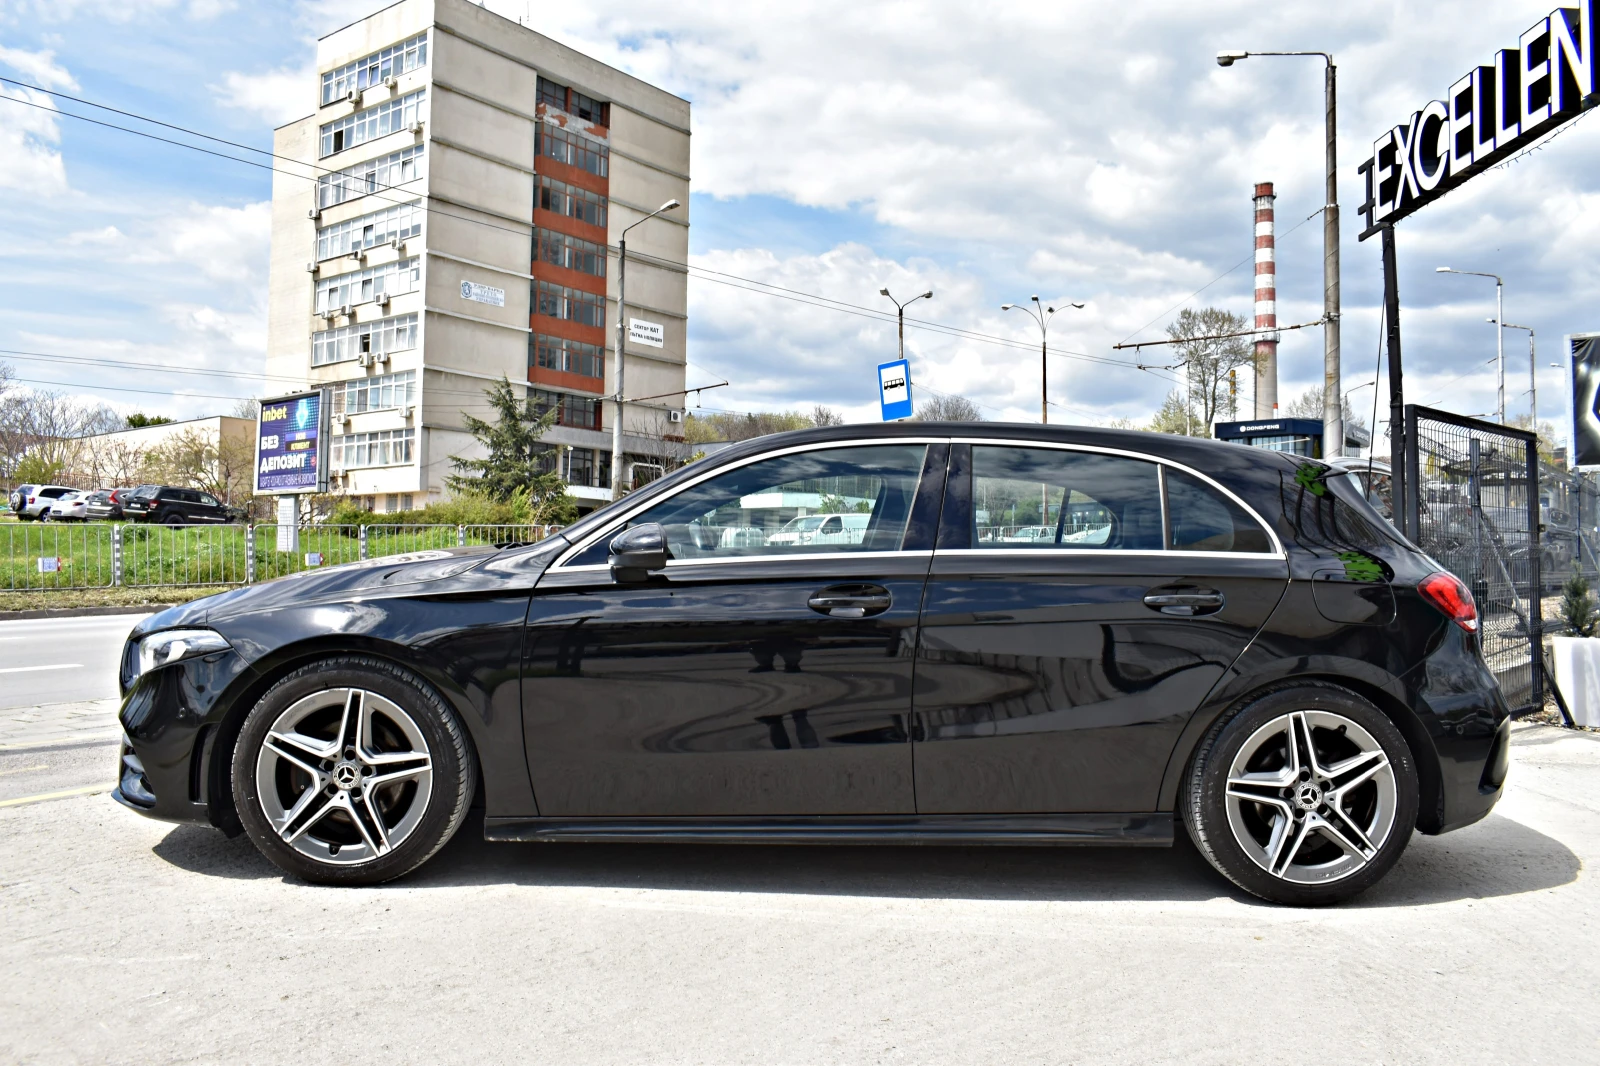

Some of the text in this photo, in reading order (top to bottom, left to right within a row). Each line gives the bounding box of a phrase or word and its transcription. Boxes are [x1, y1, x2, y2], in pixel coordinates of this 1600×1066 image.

[262, 405, 287, 422] inbet
[260, 435, 279, 450] БЕЗ
[260, 453, 307, 473] ДЕПОЗИТ
